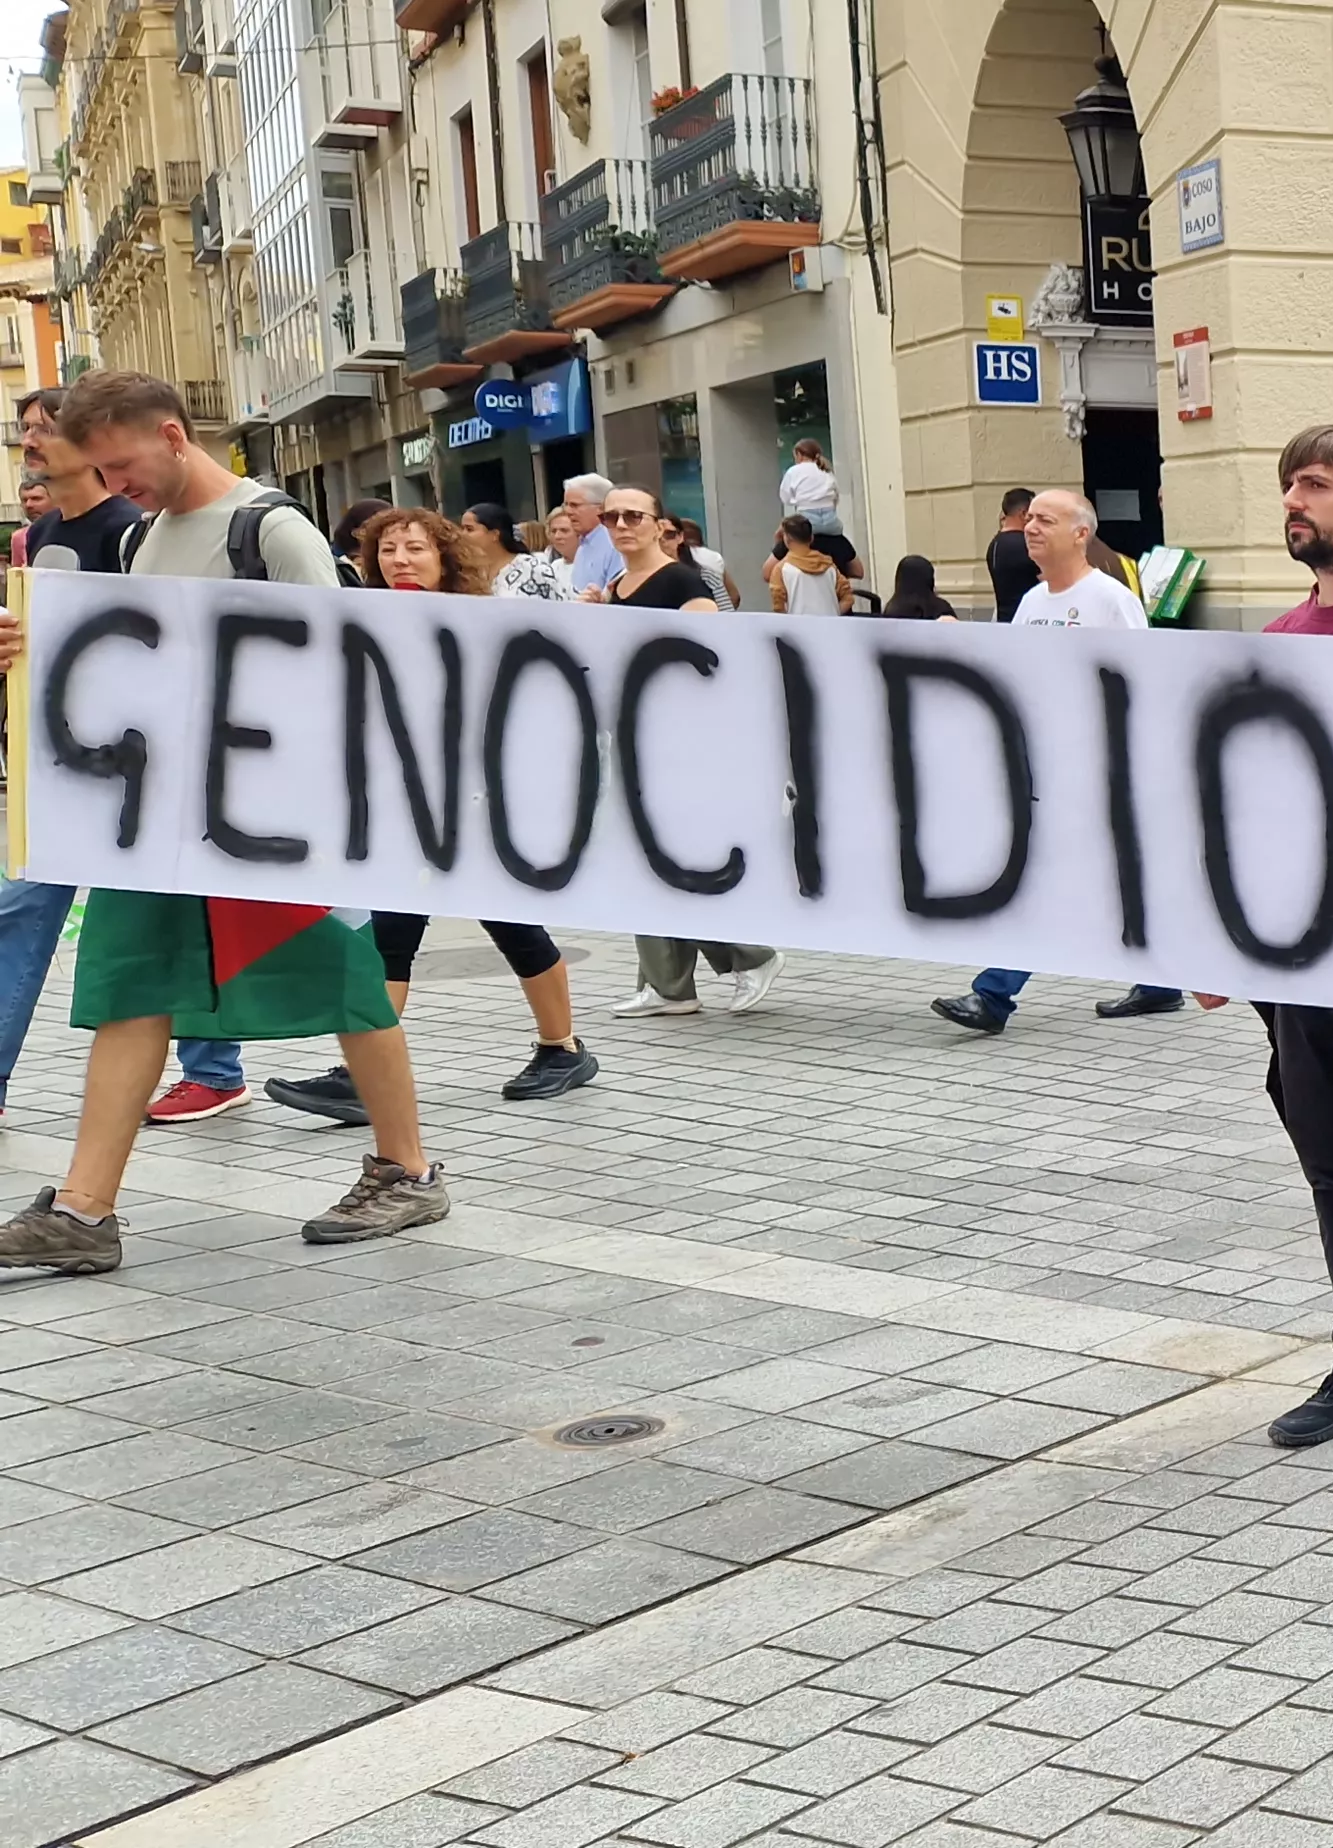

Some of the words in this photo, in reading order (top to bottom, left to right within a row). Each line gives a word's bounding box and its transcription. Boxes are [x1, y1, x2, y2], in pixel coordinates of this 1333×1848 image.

[1191, 177, 1213, 199] COSO
[1184, 212, 1217, 235] BAJO
[983, 350, 1032, 382] HS
[484, 393, 523, 409] DIGI
